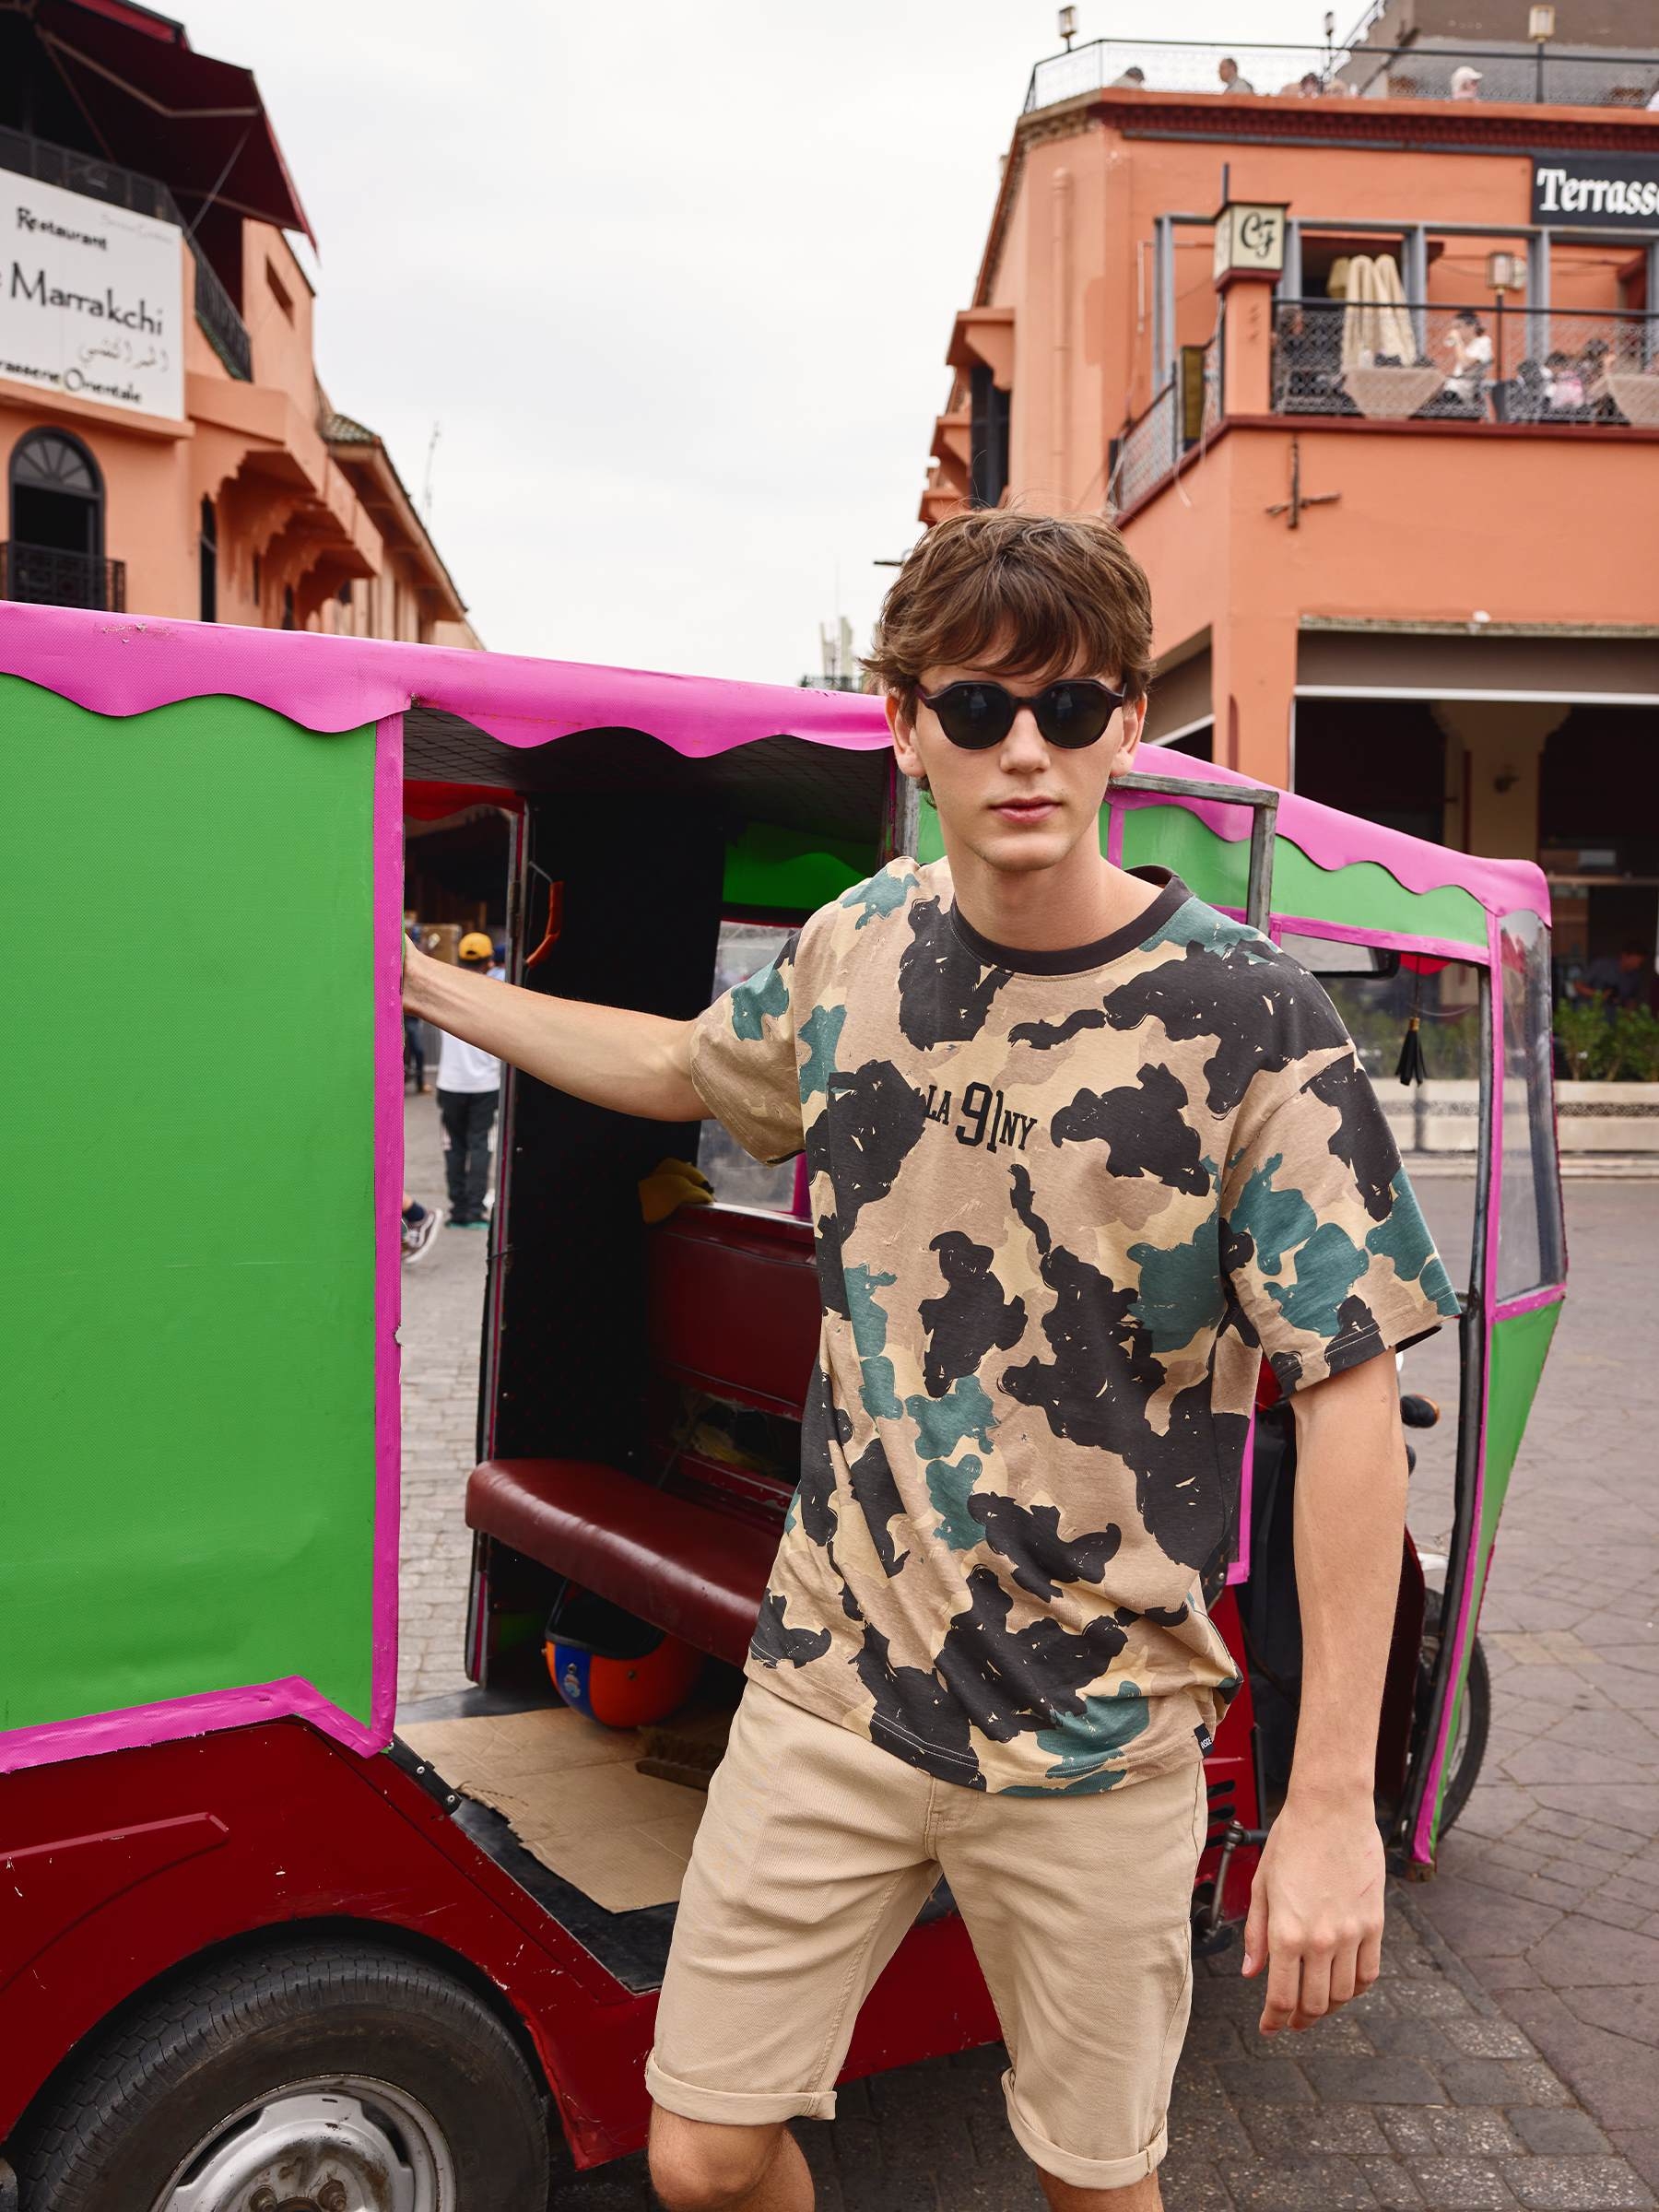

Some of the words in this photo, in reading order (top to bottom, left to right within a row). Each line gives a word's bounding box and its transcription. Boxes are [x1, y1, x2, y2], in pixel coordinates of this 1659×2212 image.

[1536, 168, 1659, 216] Terrass
[17, 206, 107, 250] Restaurant
[10, 261, 162, 336] Marrakchi
[924, 1084, 952, 1125] LA
[955, 1081, 1004, 1154] 91
[999, 1109, 1038, 1151] NY
